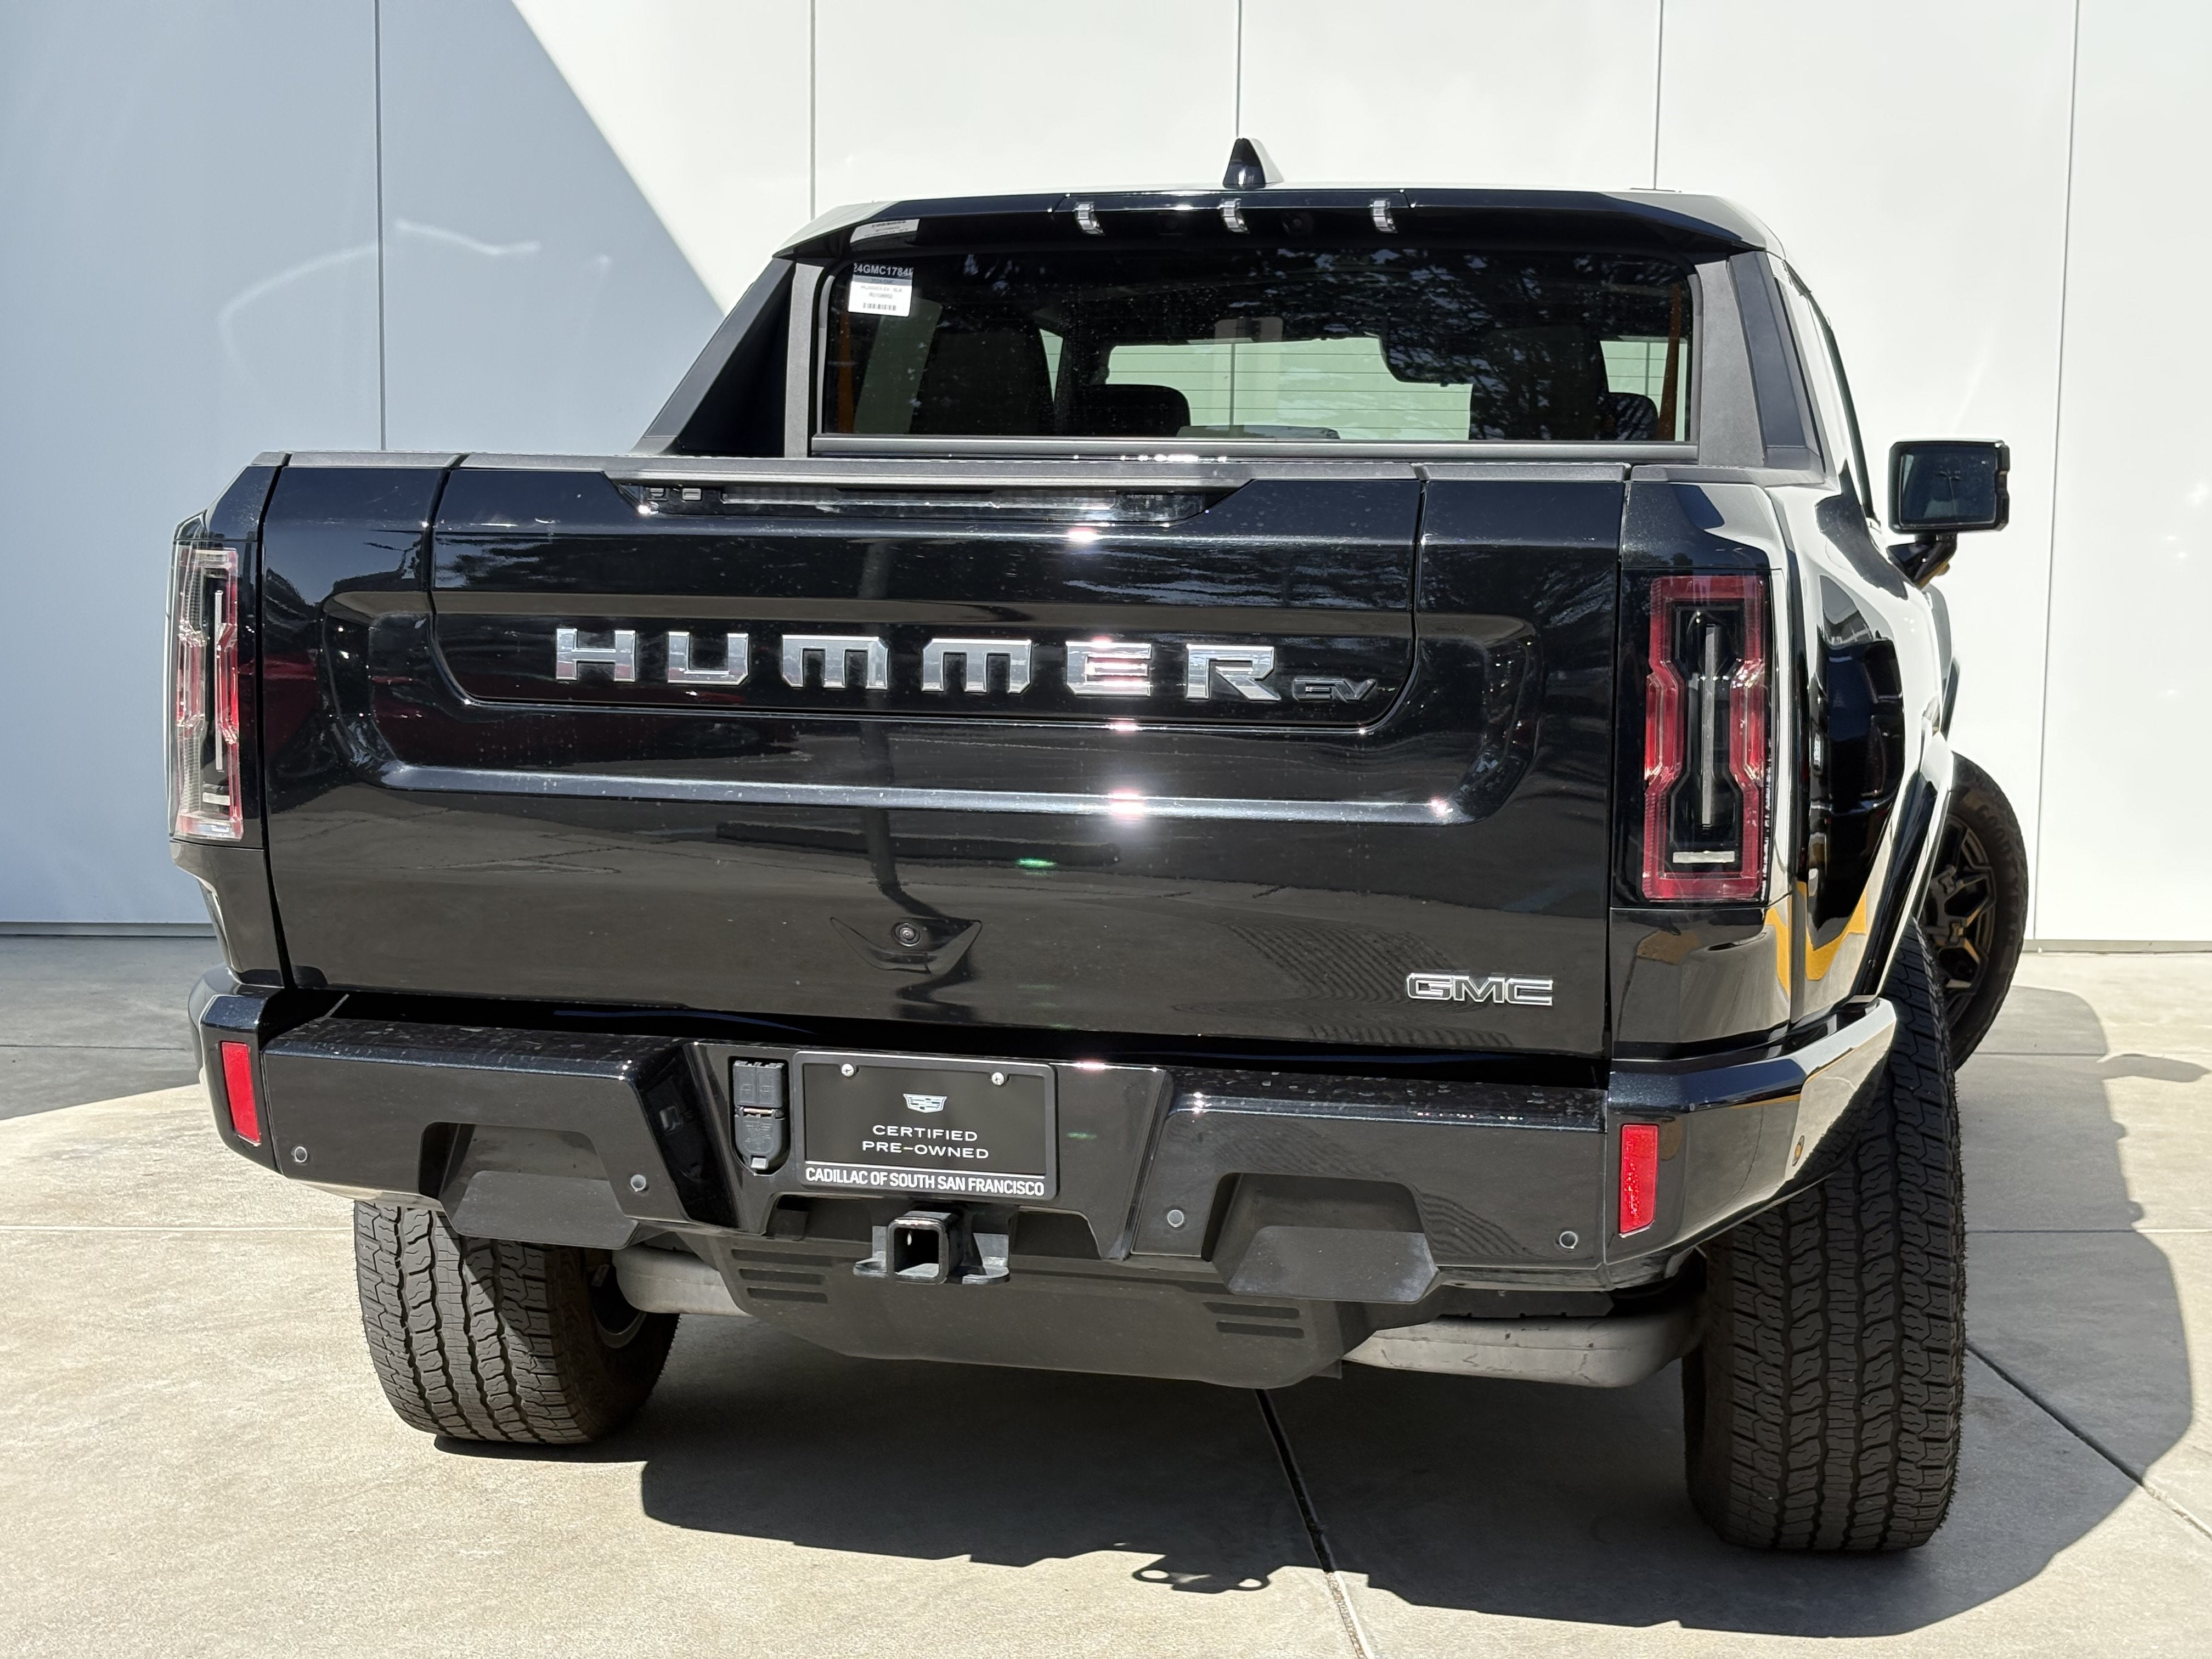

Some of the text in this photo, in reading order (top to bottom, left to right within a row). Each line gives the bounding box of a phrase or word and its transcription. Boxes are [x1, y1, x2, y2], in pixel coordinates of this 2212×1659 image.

[556, 628, 1376, 702] HUMMER EV
[1407, 973, 1553, 1006] GMC
[872, 1125, 978, 1142] CERTIFIED
[862, 1141, 989, 1159] PRE-OWNED
[806, 1167, 1045, 1196] CADILLAC OF SOUTH SAN FRANCISCO
